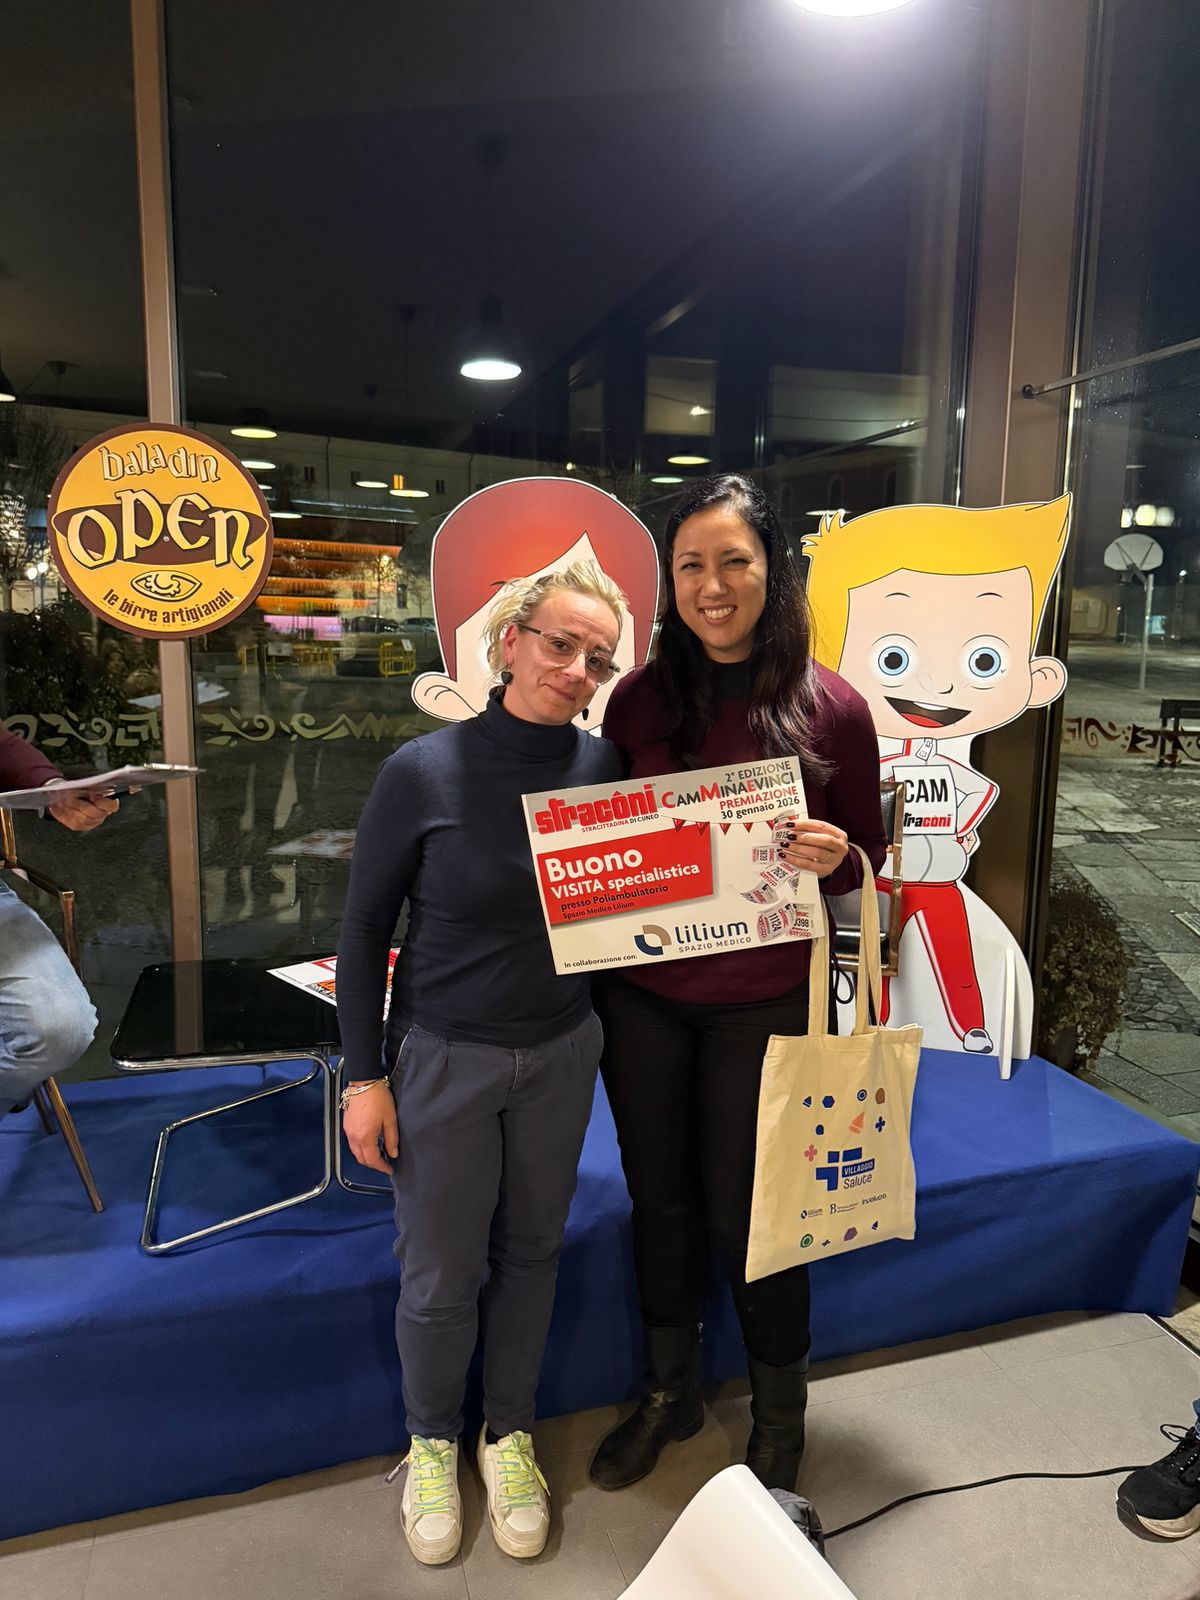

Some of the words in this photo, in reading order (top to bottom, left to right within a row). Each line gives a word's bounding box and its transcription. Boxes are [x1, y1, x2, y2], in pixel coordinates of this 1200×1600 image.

[102, 588, 119, 605] le
[119, 600, 158, 622] birre
[162, 588, 235, 624] artigianali
[738, 761, 792, 779] EDIZIONE
[720, 785, 799, 810] PREMIAZIONE
[904, 778, 949, 803] CAM
[720, 810, 733, 820] 30
[736, 801, 775, 819] gennaio
[777, 796, 800, 808] 2026
[581, 819, 629, 832] STRACITTADINA
[637, 813, 659, 823] CUNEO
[544, 849, 643, 883] Buono
[551, 878, 604, 899] VISITA
[608, 864, 700, 892] specialistica
[560, 897, 591, 912] presso
[592, 884, 669, 904] Poliambulatorio
[563, 909, 586, 920] Spazio
[586, 905, 612, 916] Medico
[613, 901, 635, 911] Lilium
[674, 921, 749, 944] lilium
[679, 942, 713, 954] SPAZIO
[716, 936, 752, 948] MEDICO
[564, 961, 571, 969] In
[572, 954, 622, 968] collaborazione
[623, 953, 638, 961] con:
[844, 1160, 874, 1175] VILLAGGIO
[843, 1173, 873, 1190] Salute
